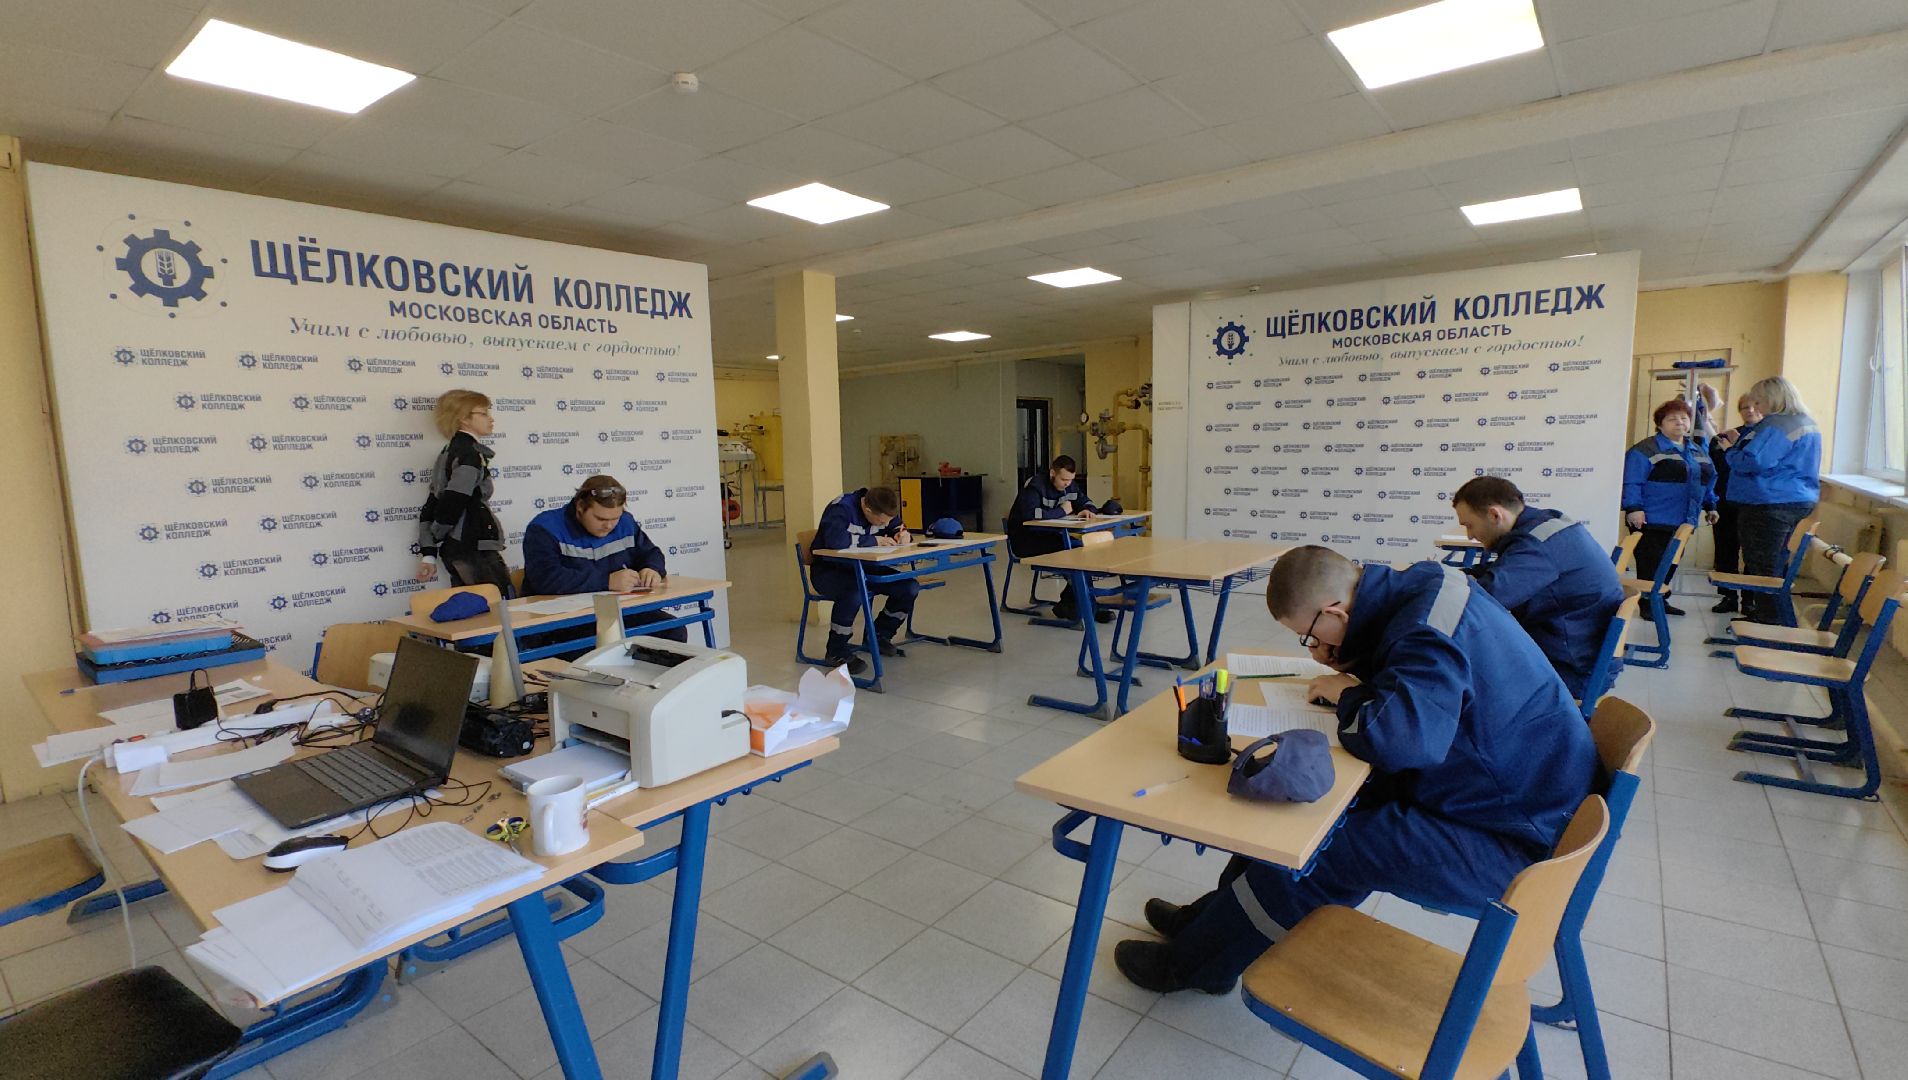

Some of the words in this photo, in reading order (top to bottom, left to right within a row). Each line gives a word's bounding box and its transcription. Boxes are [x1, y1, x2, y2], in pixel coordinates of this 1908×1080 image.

[250, 236, 534, 304] ЩЁЛКОВСКИЙ
[554, 277, 693, 320] КОЛЛЕДЖ
[1266, 294, 1436, 339] ЩЁЛКОВСКИЙ
[1454, 284, 1606, 321] КОЛЛЕДЖ
[388, 300, 532, 327] МОСКОВСКАЯ
[538, 314, 618, 334] ОБЛАСТЬ
[289, 316, 350, 338] Учим
[359, 326, 370, 338] с
[376, 327, 474, 348] любовью,
[482, 336, 577, 353] выпускаем
[596, 341, 681, 357] гордостью!
[1332, 330, 1431, 348] МОСКОВСКАЯ
[1436, 324, 1512, 340] ОБЛАСТЬ
[141, 348, 206, 359] ЩЁЛКОВСКИЙ
[261, 352, 318, 363] ЩЁЛКОВСКИЙ
[141, 358, 189, 367] КОЛЛЕДЖ
[262, 361, 303, 371] КОЛЛЕДЖ
[366, 358, 416, 367] ЩЁЛКОВСКИЙ
[367, 366, 403, 374] КОЛЛЕДЖ
[200, 392, 262, 402] ЩЁЛКОВСКИЙ
[313, 394, 367, 403] ЩЁЛКОВСКИЙ
[201, 402, 246, 411] КОЛЛЕДЖ
[313, 403, 353, 411] КОЛЛЕДЖ
[152, 436, 217, 446] ЩЁЛКОВСКИЙ
[271, 433, 328, 444] ЩЁЛКОВСКИЙ
[375, 433, 424, 441] ЩЁЛКОВСКИЙ
[152, 445, 200, 454] КОЛЛЕДЖ
[272, 443, 314, 451] КОЛЛЕДЖ
[211, 475, 272, 487] ЩЁЛКОВСКИЙ
[322, 471, 376, 481] ЩЁЛКОВСКИЙ
[323, 480, 362, 488] КОЛЛЕДЖ
[212, 485, 256, 494] КОЛЛЕДЖ
[384, 506, 422, 514] ЩЁЛКОВСК
[281, 511, 337, 523] ЩЁЛКОВСКИЙ
[164, 518, 228, 532] ЩЁЛКОВСКИЙ
[282, 520, 323, 530] КОЛЛЕДЖ
[165, 529, 212, 540] КОЛЛЕДЖ
[332, 545, 384, 557] ЩЁЛКОВСКИЙ
[222, 554, 282, 569] ЩЁЛКОВСКИЙ
[333, 554, 370, 564] КОЛЛЕДЖ
[224, 566, 267, 576] КОЛЛЕДЖ
[292, 587, 346, 601] ЩЁЛКОВСКИЙ
[392, 584, 426, 594] КОЛЛЕДЖ
[293, 596, 332, 608] КОЛЛЕДЖ
[176, 600, 239, 616] ЩЁЛКОВСКИЙ
[259, 633, 292, 643] ОВСКИЙ
